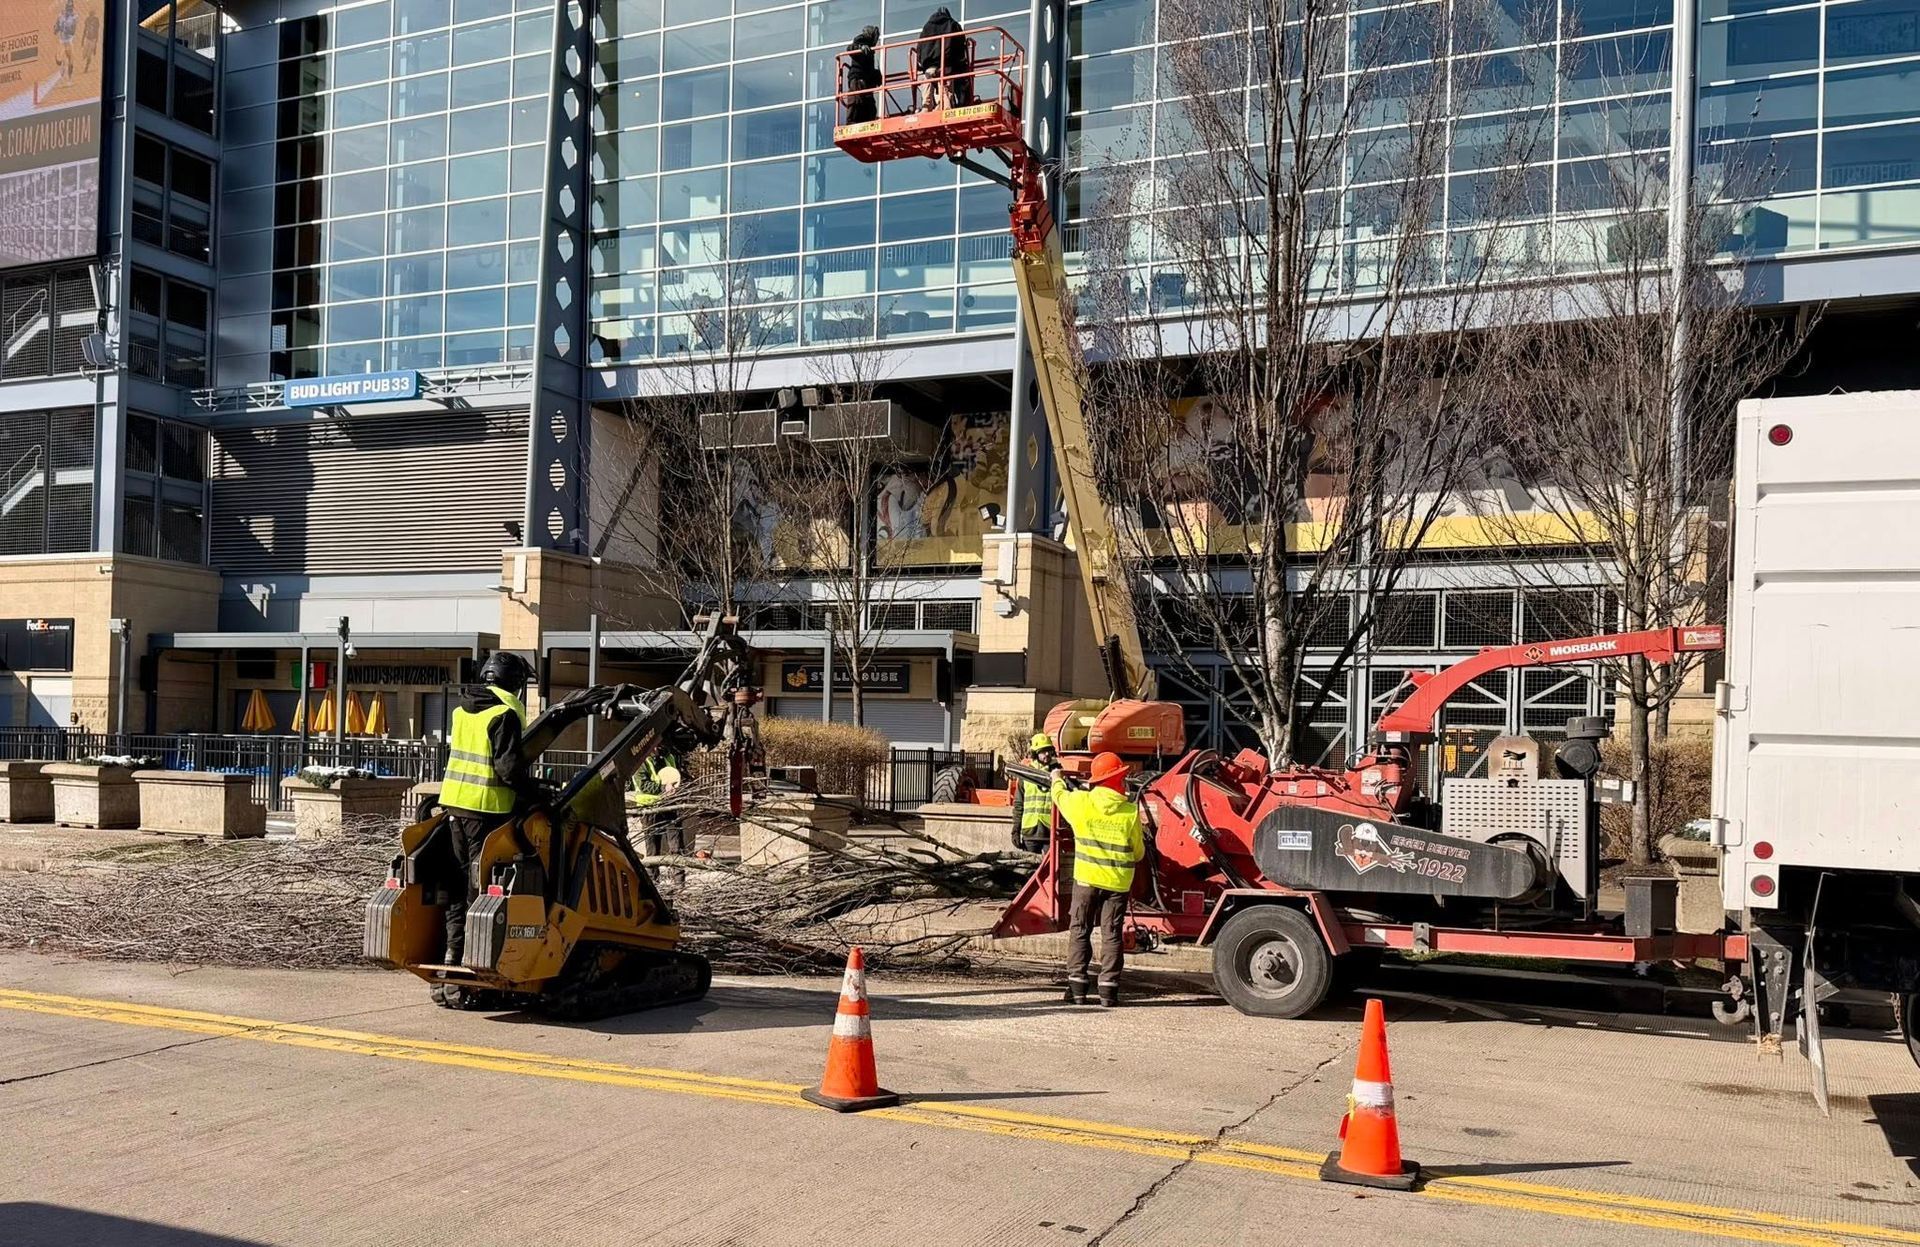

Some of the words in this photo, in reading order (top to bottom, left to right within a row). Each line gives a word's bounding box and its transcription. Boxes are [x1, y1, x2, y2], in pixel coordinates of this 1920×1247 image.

[8, 34, 39, 50] HONOR
[291, 385, 319, 399] BUD
[321, 382, 360, 396] LIGHT
[363, 379, 391, 394] PUB
[392, 377, 410, 390] 33
[26, 619, 49, 631] FedEx
[1550, 640, 1617, 656] MORBARK
[1416, 857, 1467, 884] 1922
